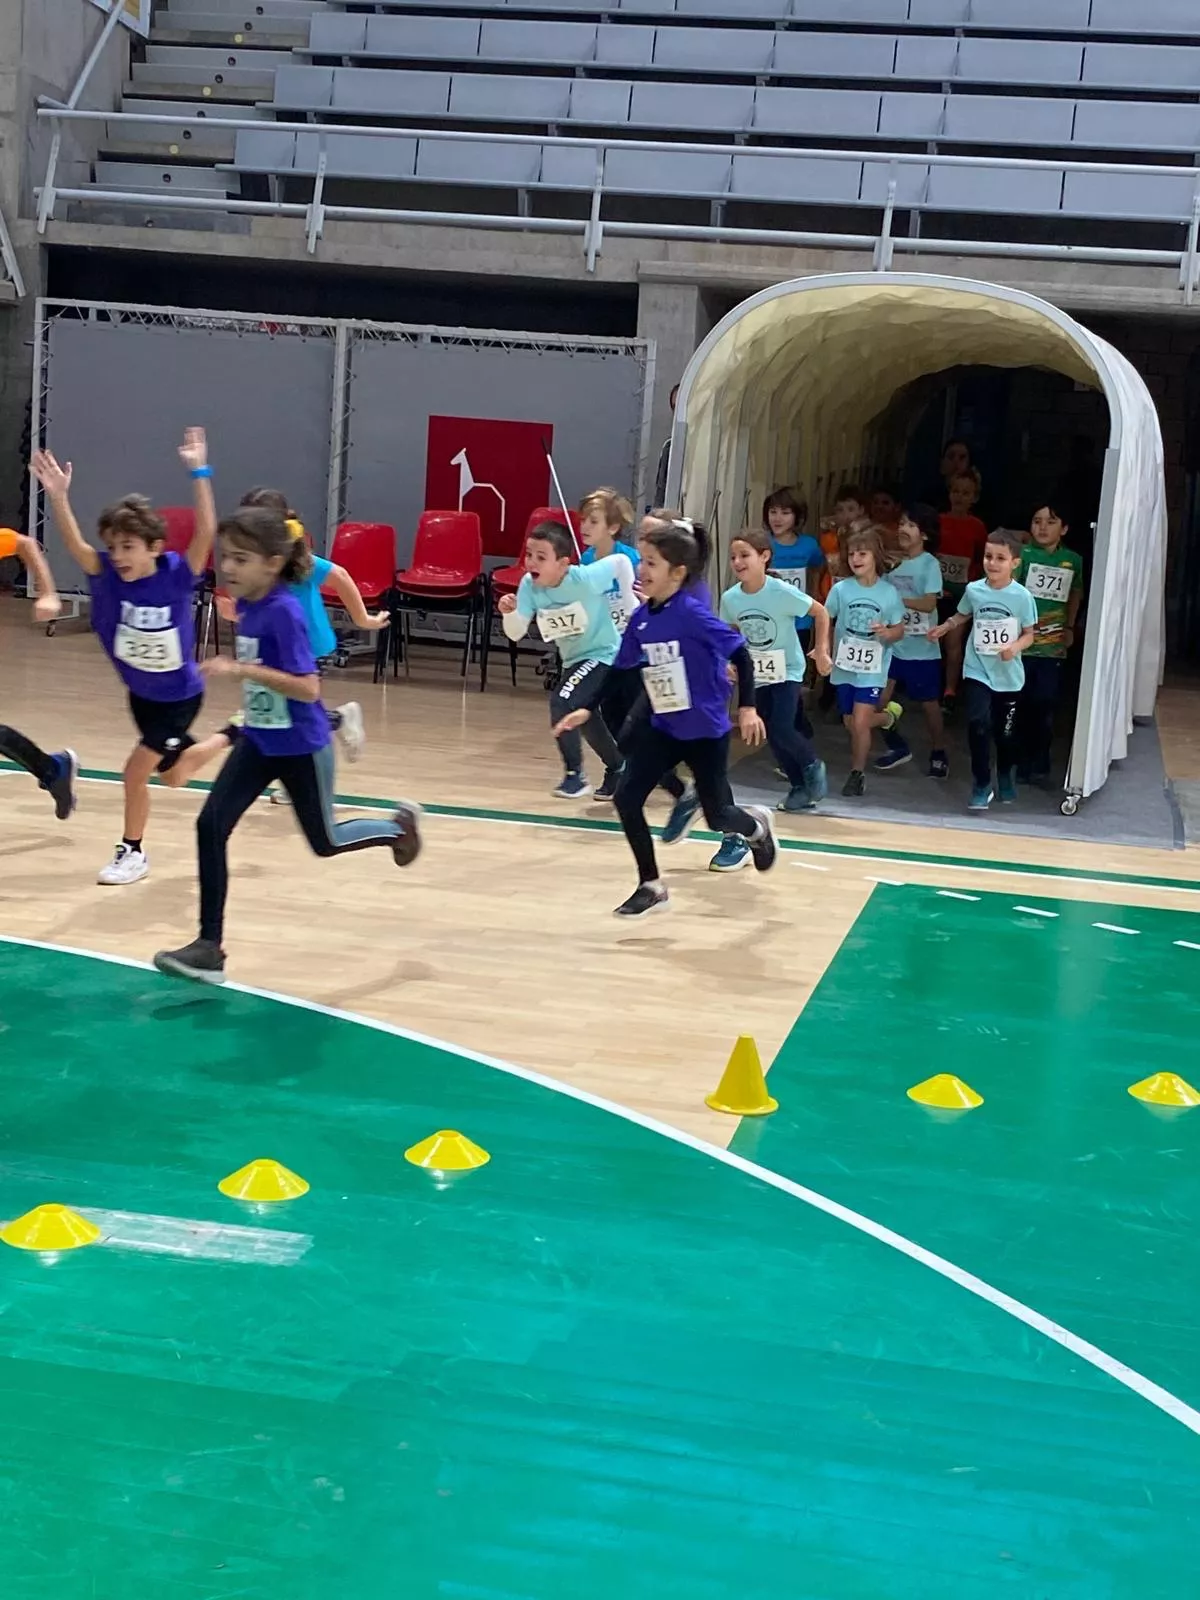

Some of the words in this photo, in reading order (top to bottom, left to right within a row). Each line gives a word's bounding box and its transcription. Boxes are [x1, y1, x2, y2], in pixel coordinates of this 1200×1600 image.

[1035, 574, 1063, 591] 371
[546, 613, 577, 629] 317
[902, 611, 921, 625] 93
[982, 628, 1010, 645] 316
[125, 640, 168, 660] 323
[846, 647, 874, 664] 315
[757, 660, 776, 673] 14
[246, 690, 275, 713] 20
